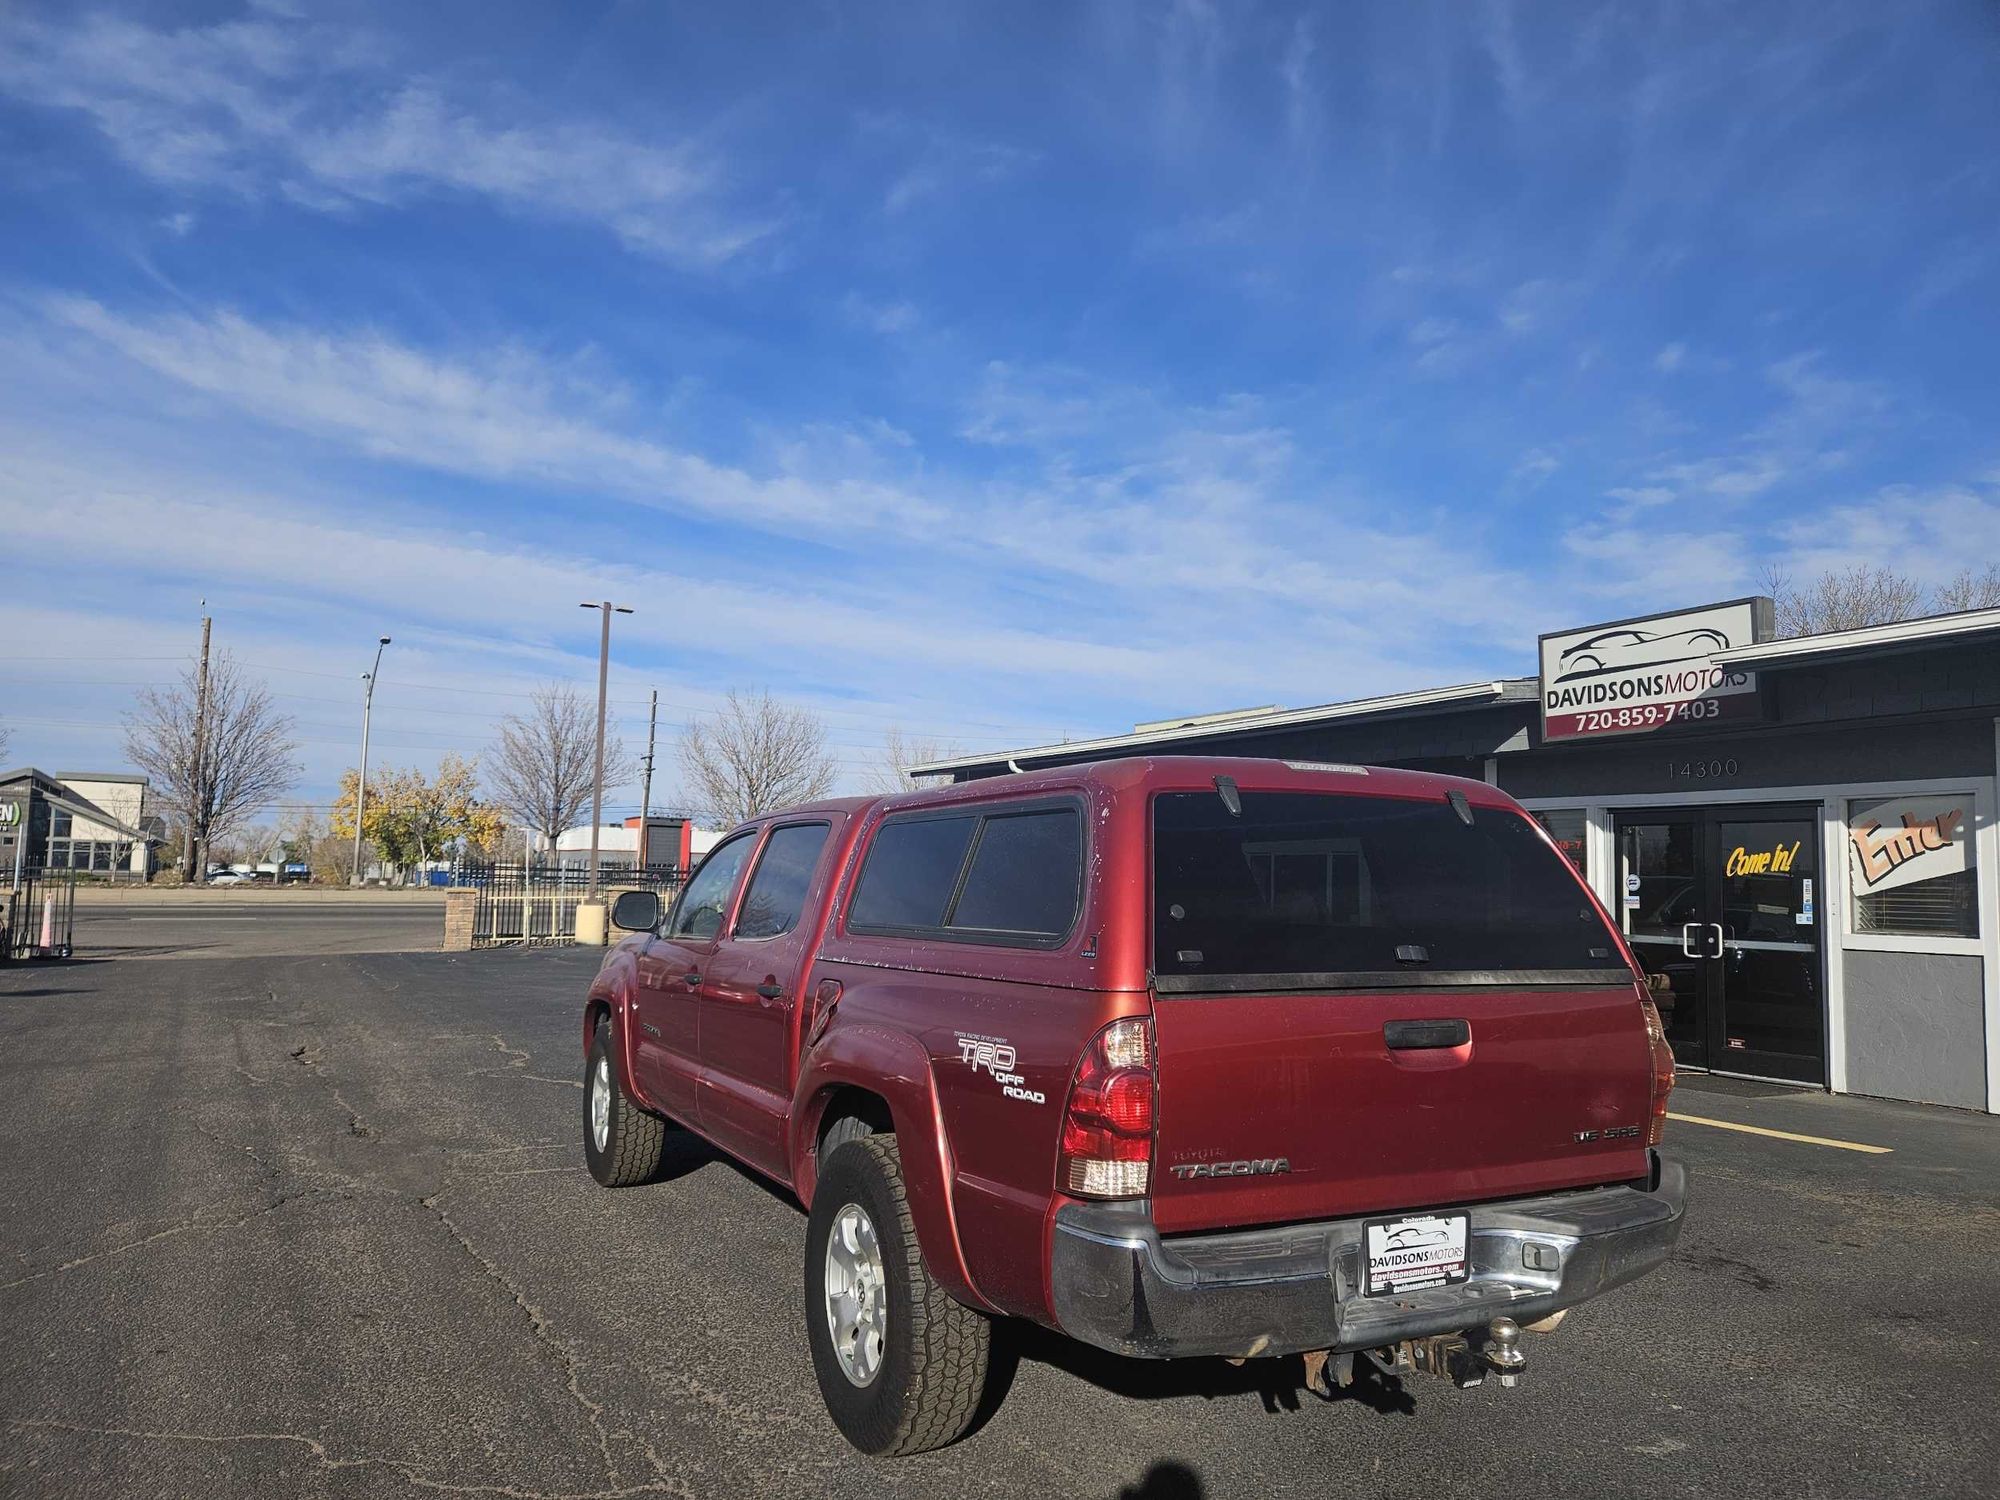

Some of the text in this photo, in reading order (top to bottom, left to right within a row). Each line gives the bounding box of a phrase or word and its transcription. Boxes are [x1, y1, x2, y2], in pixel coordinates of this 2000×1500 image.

[1576, 700, 1720, 732] 720-859-7403
[1669, 759, 1737, 778] 14300
[1851, 808, 1963, 887] Enter
[1726, 841, 1801, 877] Come in!
[958, 1038, 1016, 1076] TRD
[995, 1072, 1025, 1086] OFF
[1003, 1086, 1046, 1105] ROAD
[1170, 1158, 1290, 1179] TACOMA
[1402, 1215, 1436, 1224] Colorado
